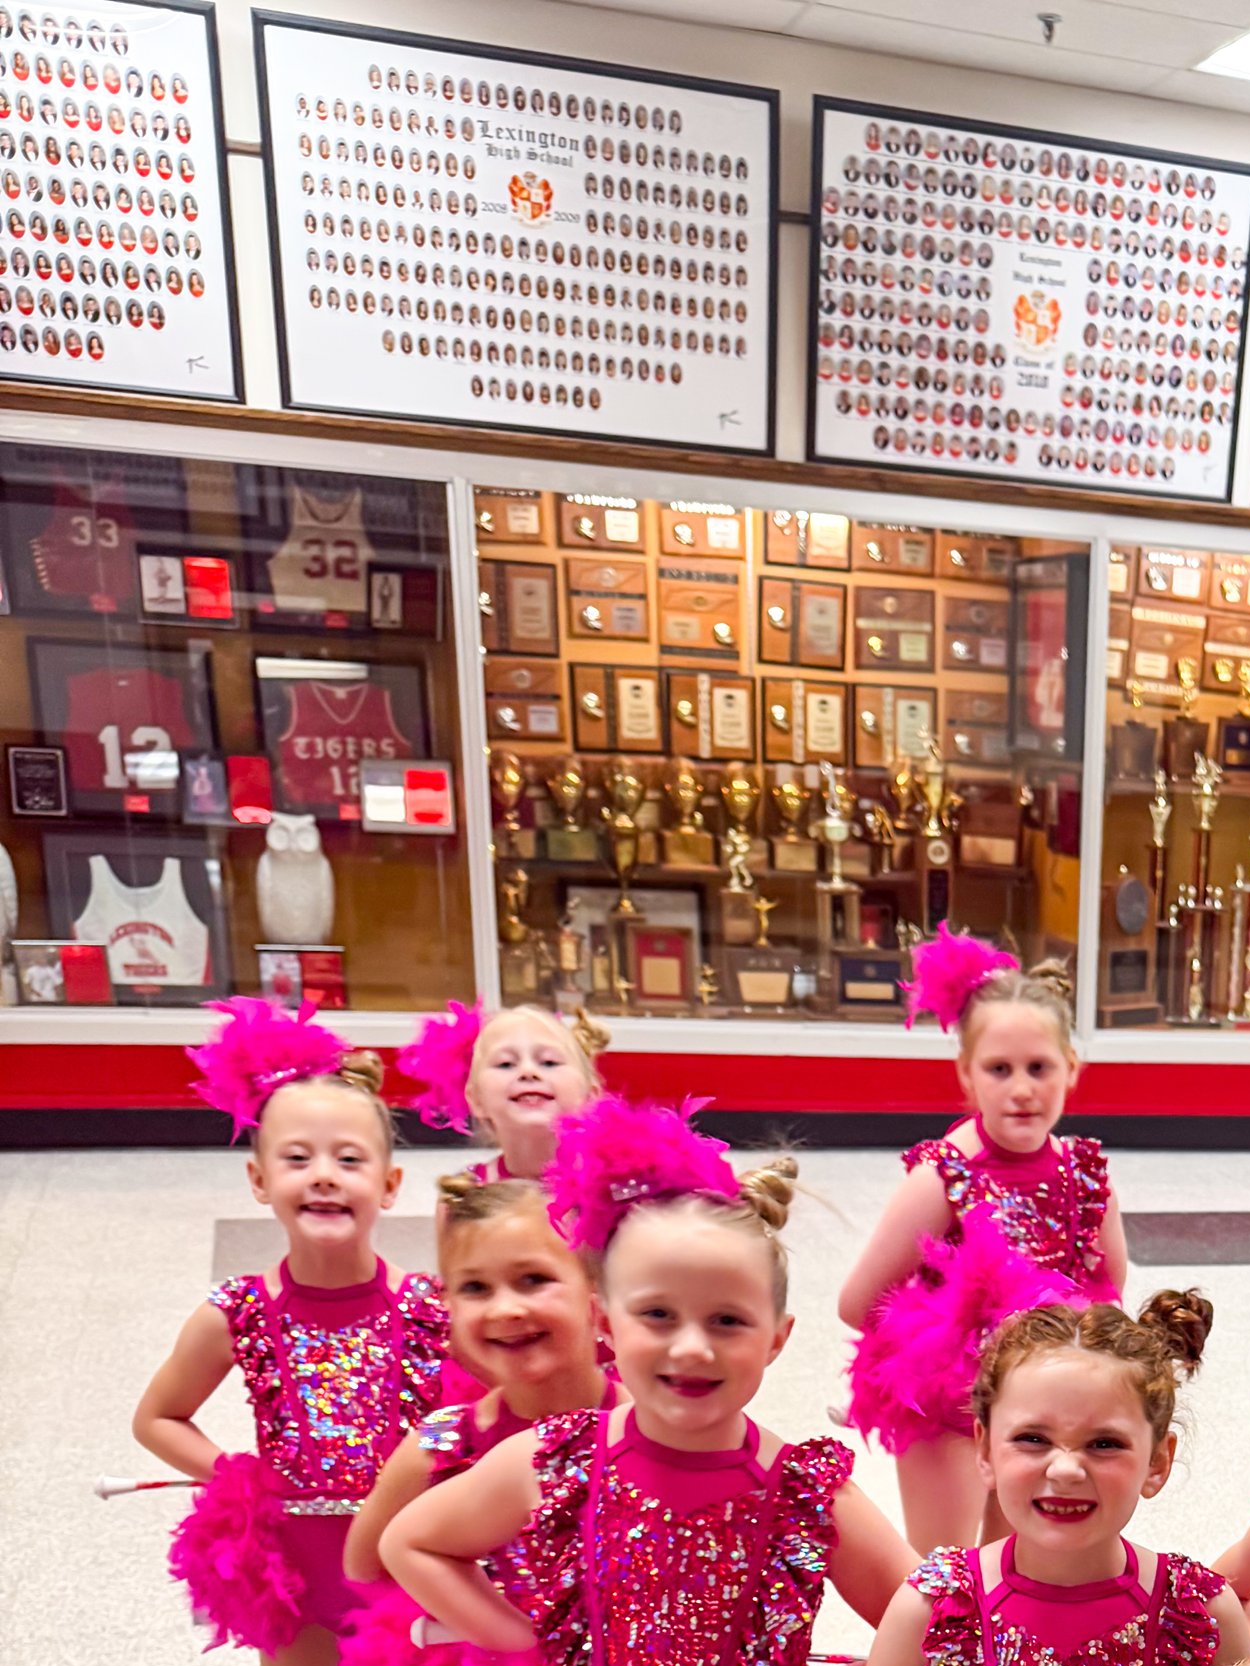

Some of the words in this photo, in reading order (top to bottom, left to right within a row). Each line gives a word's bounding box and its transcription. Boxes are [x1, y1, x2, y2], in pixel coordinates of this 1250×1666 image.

[477, 119, 580, 152] Lexington
[485, 142, 521, 160] High
[525, 149, 574, 168] School
[70, 515, 119, 549] 33
[302, 538, 361, 581] 32
[98, 725, 177, 789] 12
[293, 735, 396, 760] TIGERS
